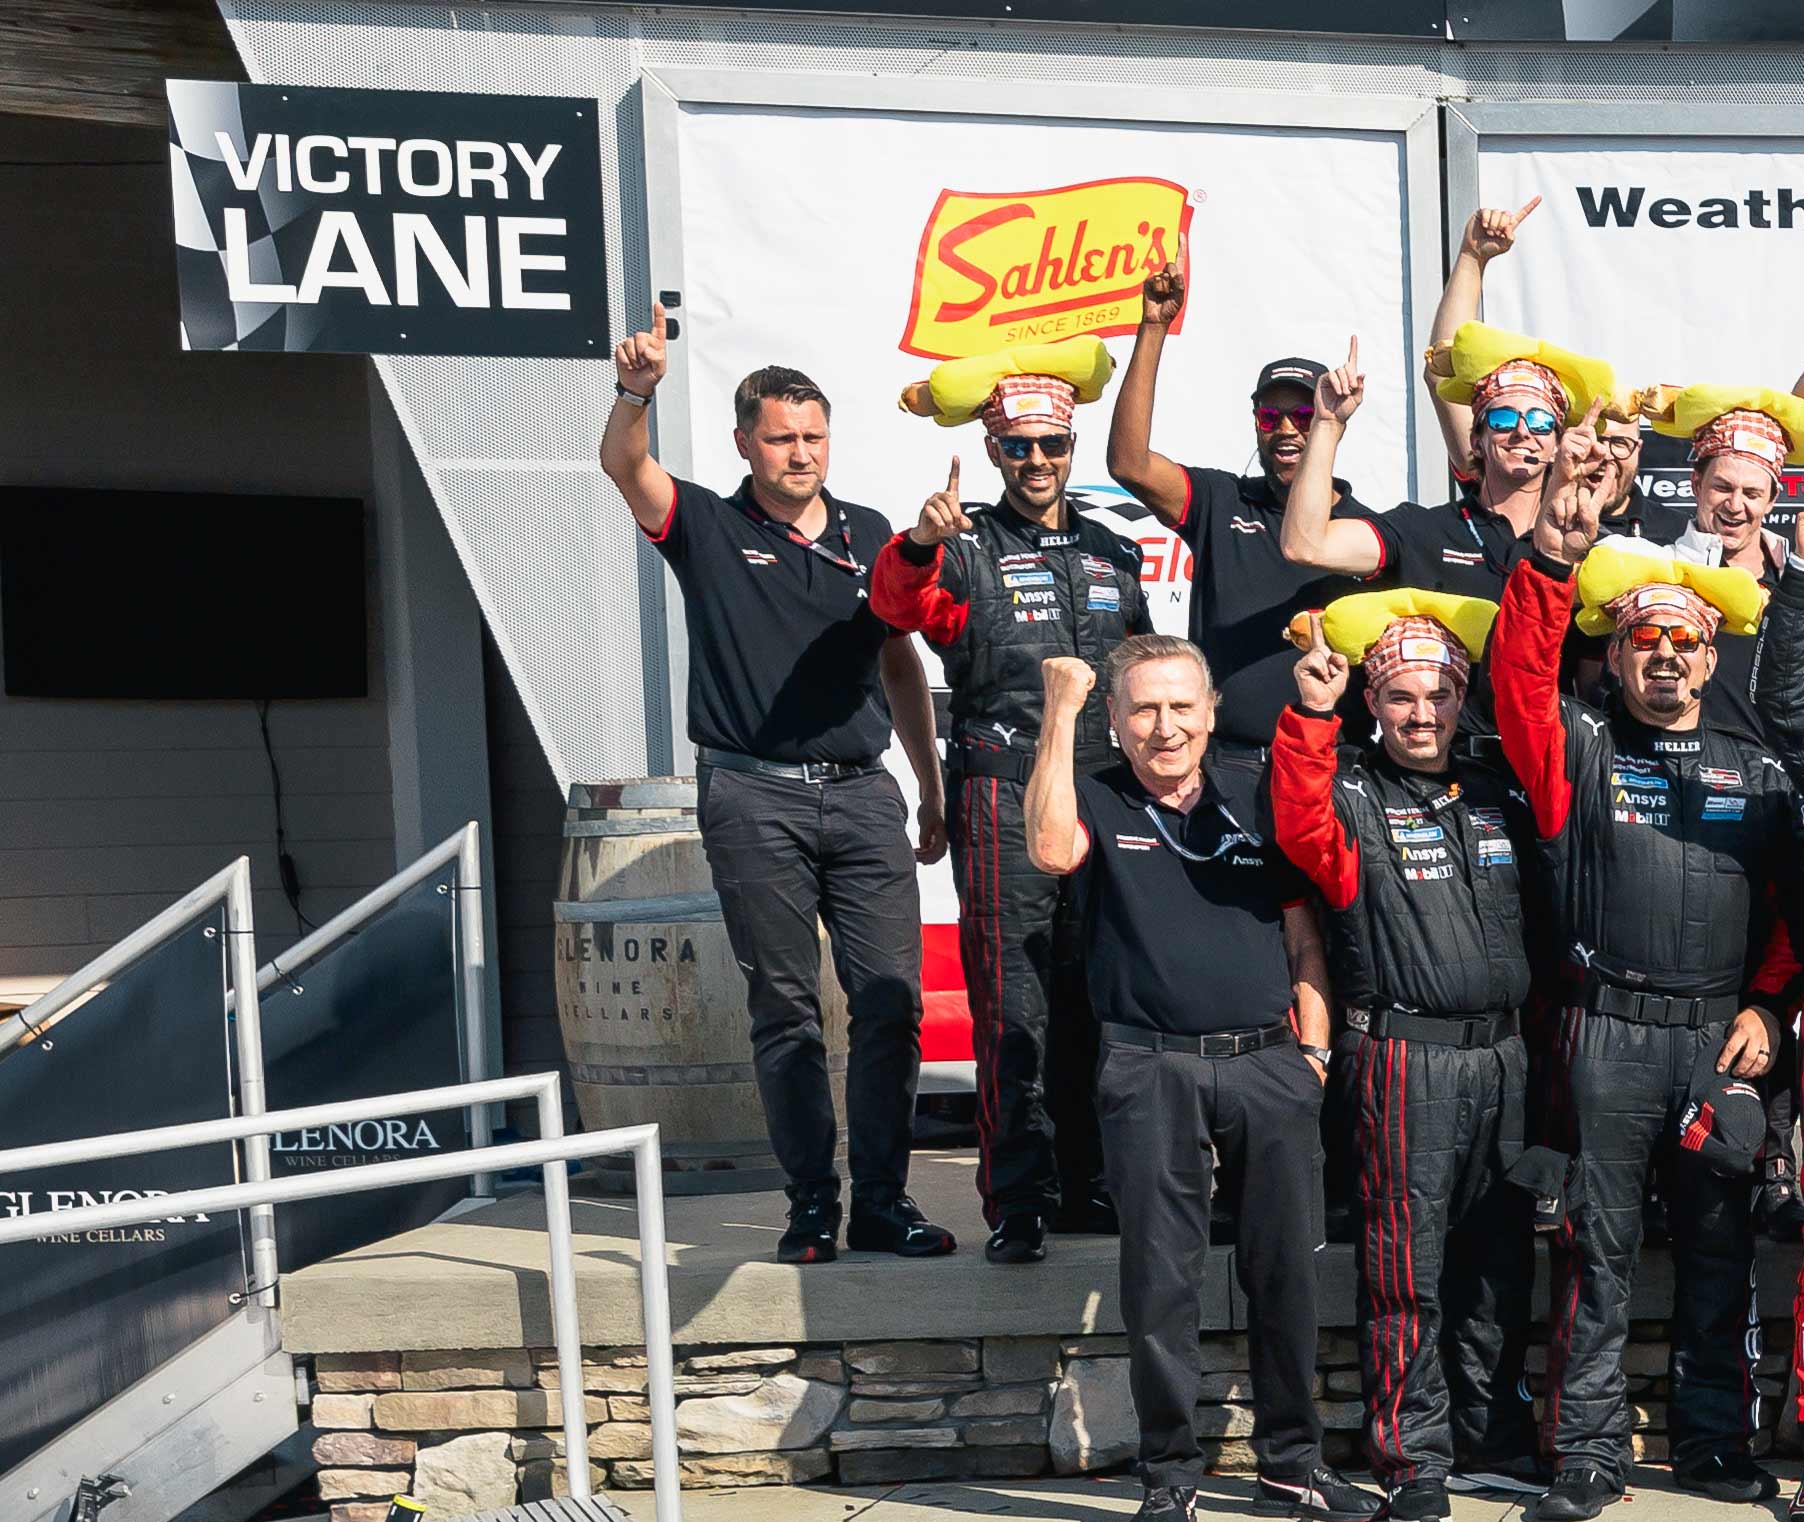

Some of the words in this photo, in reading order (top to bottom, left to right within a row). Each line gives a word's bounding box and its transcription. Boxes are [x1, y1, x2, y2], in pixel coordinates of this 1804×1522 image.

[214, 131, 562, 200] VICTORY
[223, 208, 571, 310] LANE
[934, 203, 1167, 323] Sahlen's
[1005, 320, 1065, 343] SINCE
[1075, 307, 1121, 328] 1869
[1013, 591, 1056, 605] Ansys
[1014, 610, 1049, 623] Mobil
[1654, 741, 1700, 752] HELLER
[1616, 789, 1667, 807] Ansys
[1615, 810, 1653, 825] Mobil
[1402, 847, 1447, 862] Ansys
[1404, 867, 1440, 881] Mobil
[580, 981, 641, 995] WINE
[270, 1120, 440, 1151] LENORA
[285, 1155, 325, 1168] WINE
[36, 1230, 80, 1243] WINE
[87, 1228, 165, 1243] CELLARS
